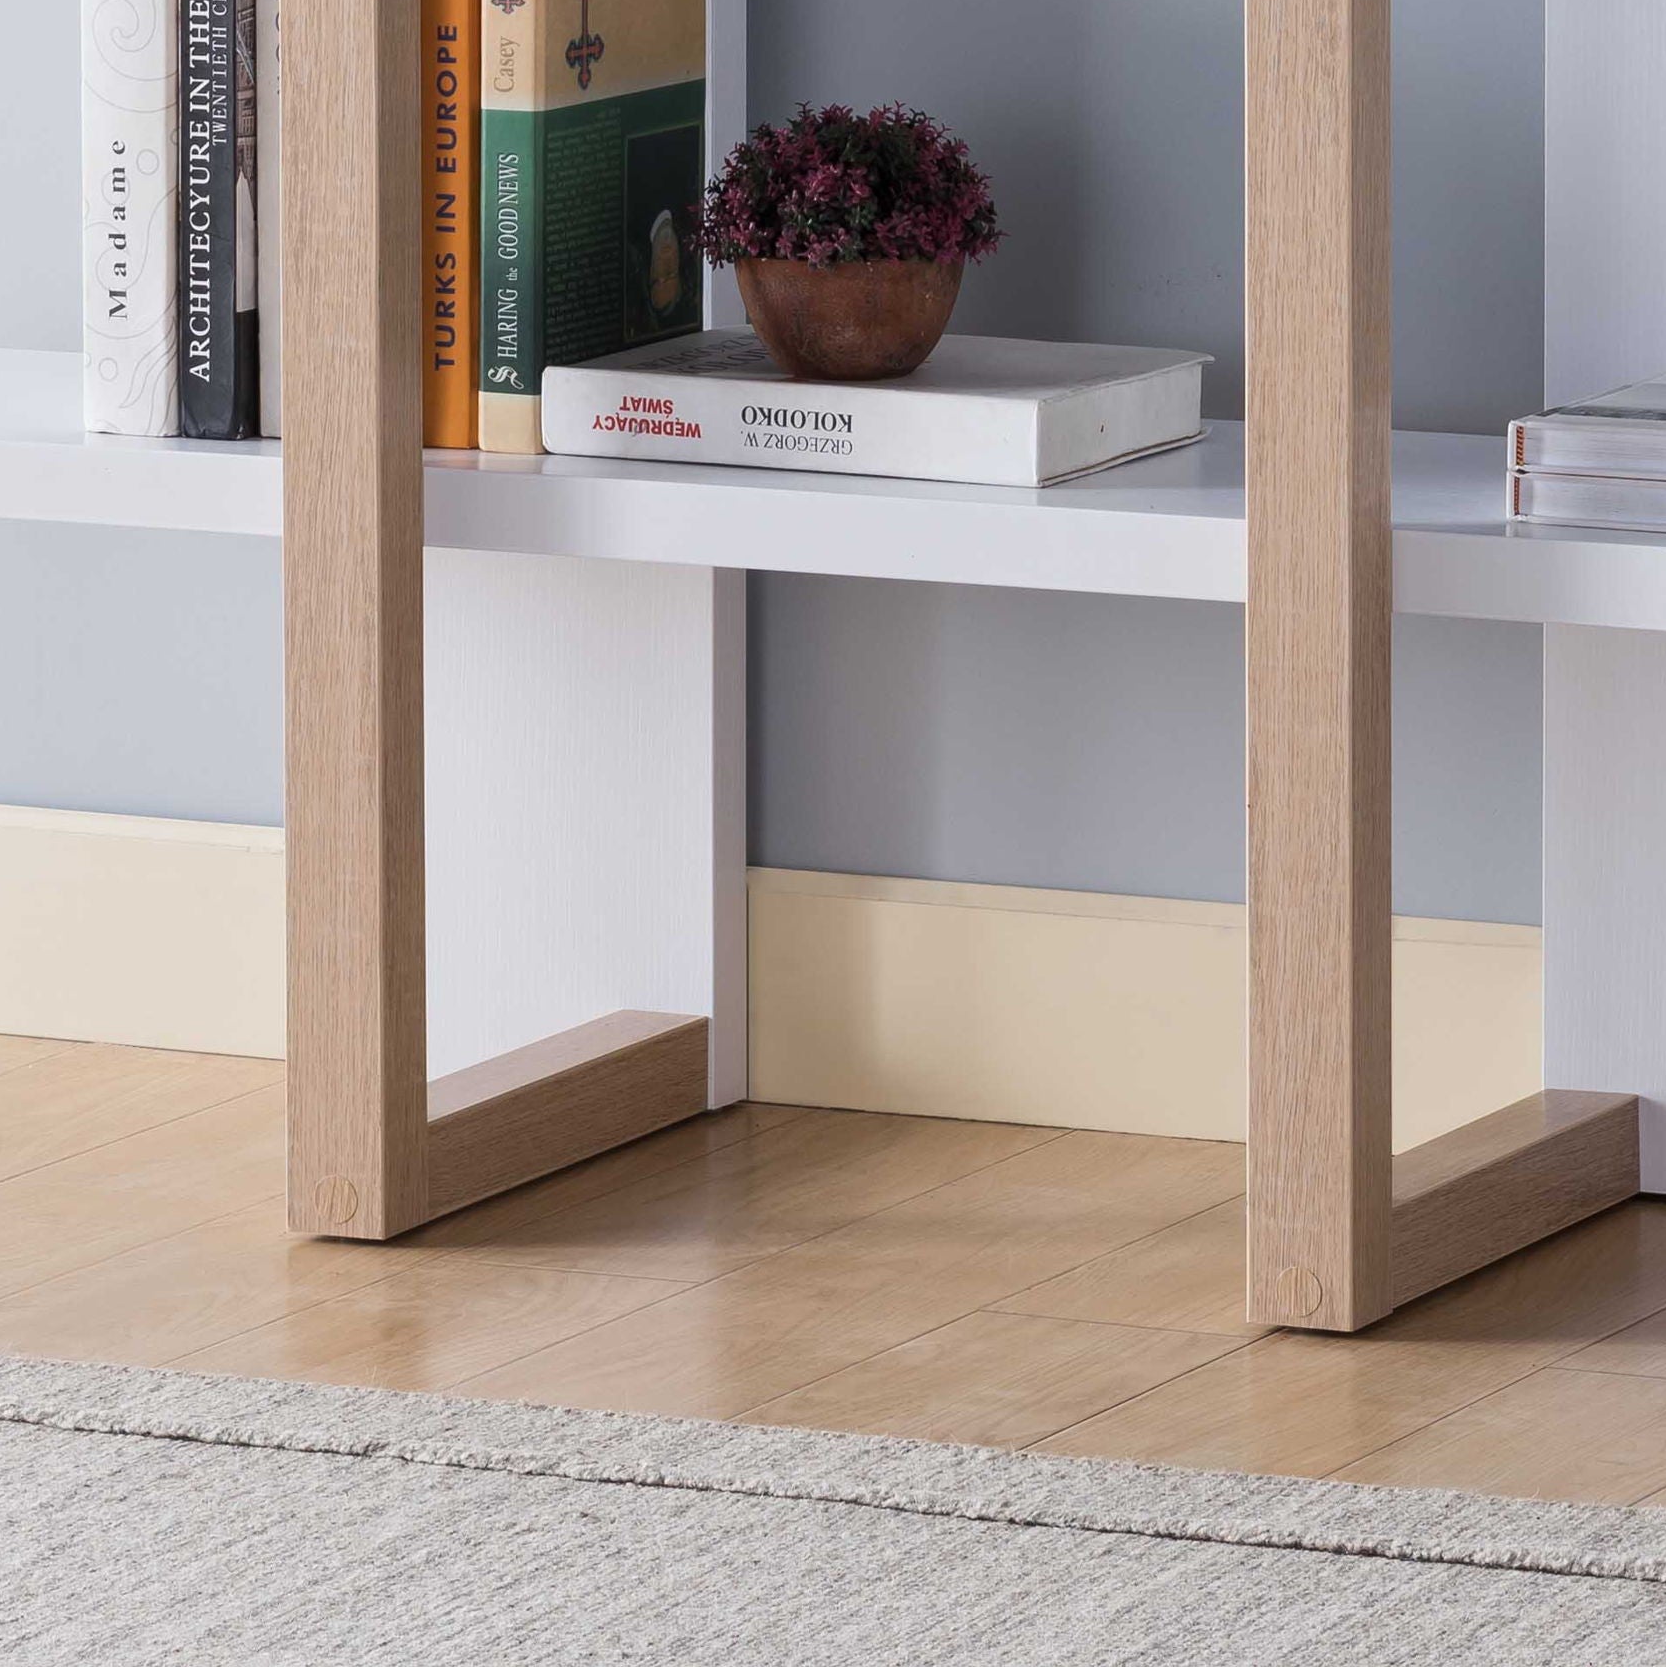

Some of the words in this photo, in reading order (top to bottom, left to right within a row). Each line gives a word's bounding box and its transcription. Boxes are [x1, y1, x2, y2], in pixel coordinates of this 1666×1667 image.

[188, 0, 211, 64] THE
[211, 27, 227, 147] TWENTIETH
[493, 35, 520, 94] Casey
[188, 78, 211, 113] IN
[435, 24, 458, 173] EUROPE
[108, 139, 128, 321] Madame
[435, 192, 456, 233] IN
[188, 120, 211, 383] ARCHITECYURE
[505, 267, 518, 281] the
[434, 252, 456, 371] TURKS
[740, 431, 759, 448] W.
[741, 405, 853, 434] KOLODKO
[763, 433, 853, 456] GRZEGORZ
